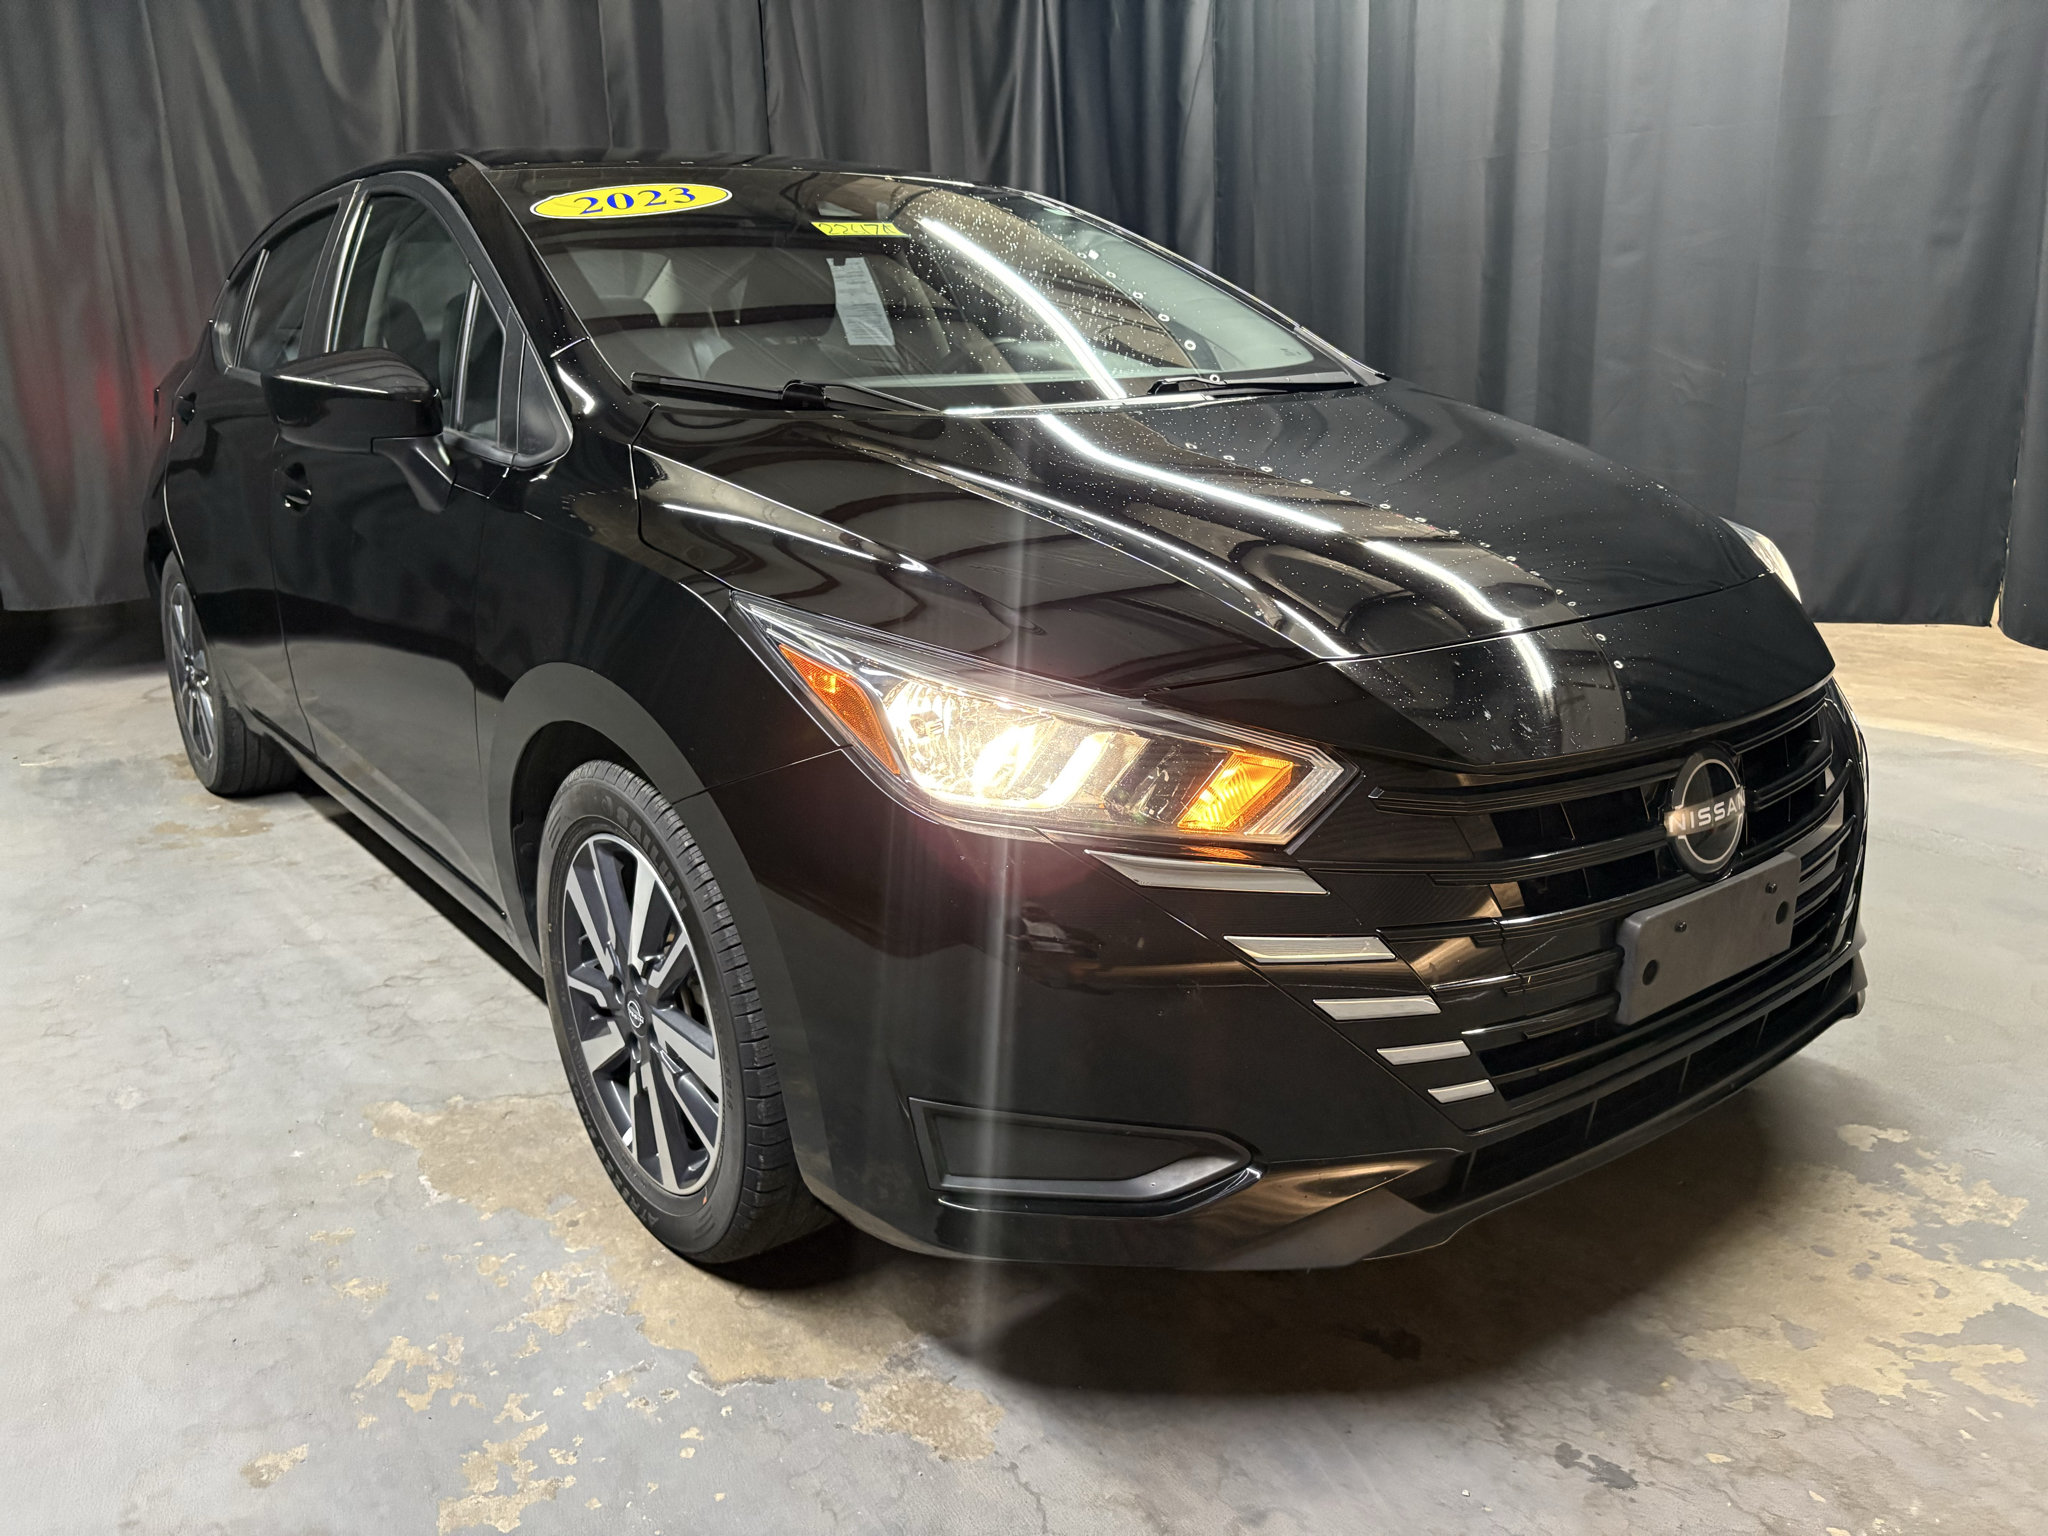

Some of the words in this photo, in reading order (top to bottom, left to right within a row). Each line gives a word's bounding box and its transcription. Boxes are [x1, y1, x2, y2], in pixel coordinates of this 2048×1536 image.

[573, 186, 697, 215] 2023
[1668, 789, 1746, 833] NISSAN
[616, 806, 688, 912] SAILUN
